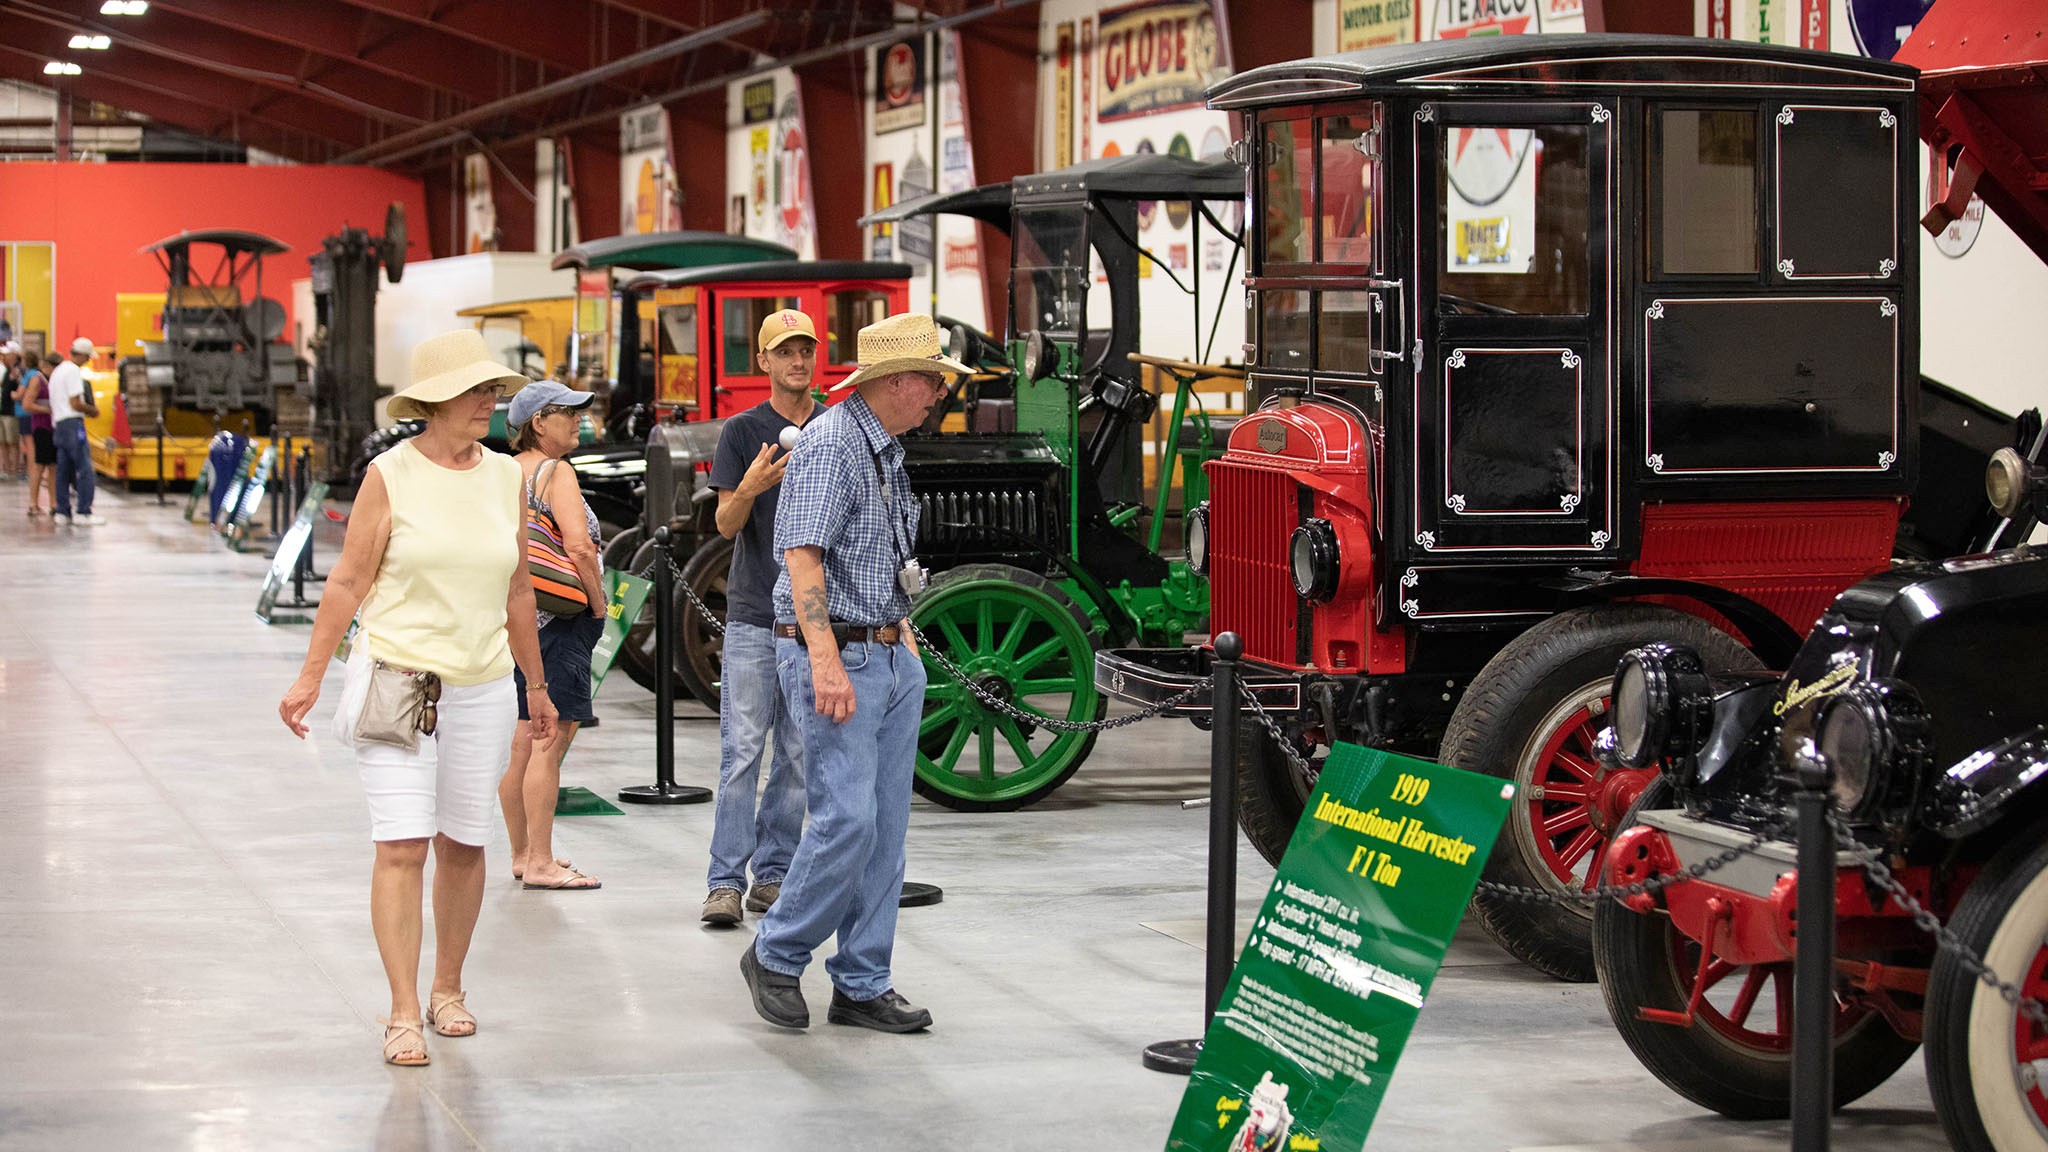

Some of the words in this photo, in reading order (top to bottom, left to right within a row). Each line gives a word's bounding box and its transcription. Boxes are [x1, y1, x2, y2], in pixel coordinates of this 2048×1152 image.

[1105, 19, 1187, 91] GLOBE
[1390, 773, 1430, 806] 1919
[1314, 792, 1407, 844] International
[1400, 817, 1476, 865] Harvester
[1347, 844, 1367, 873] F
[1360, 850, 1375, 877] 1
[1372, 852, 1401, 887] Ton
